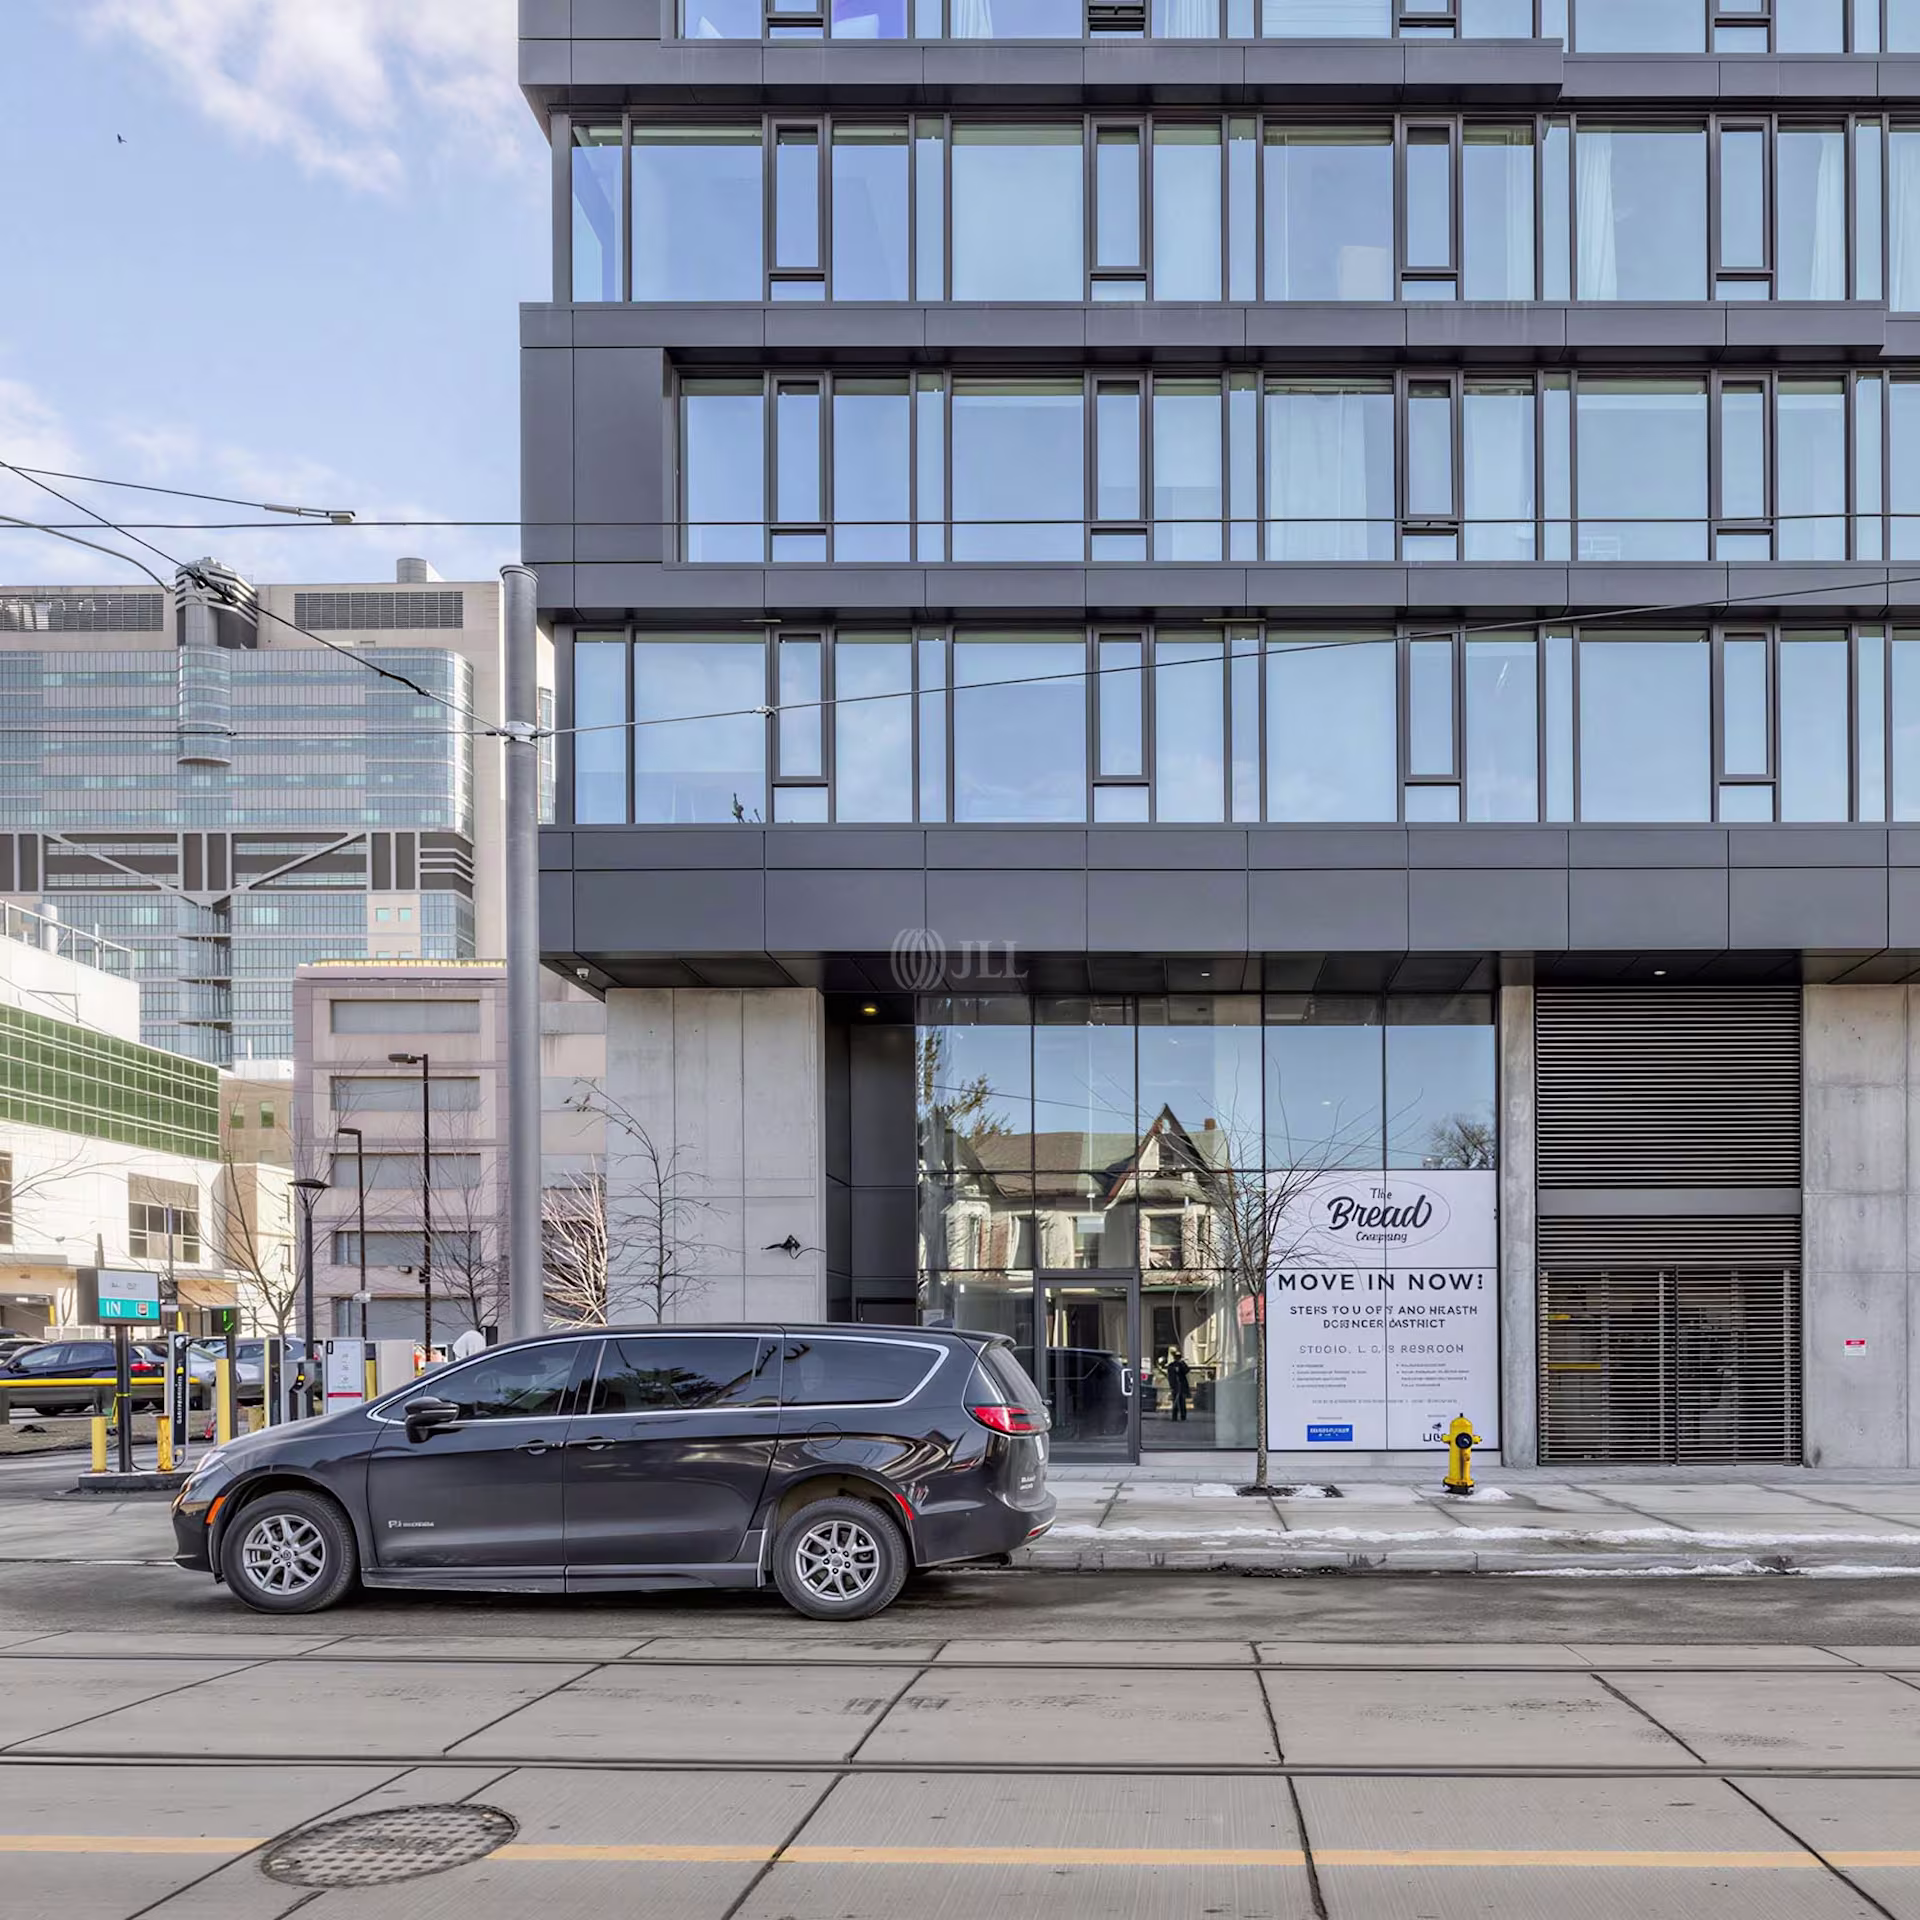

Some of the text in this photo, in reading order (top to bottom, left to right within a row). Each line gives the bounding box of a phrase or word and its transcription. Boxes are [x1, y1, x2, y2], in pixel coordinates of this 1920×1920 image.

[1327, 1194, 1433, 1231] Bread
[1278, 1273, 1484, 1291] MOVE IN NOW!
[105, 1300, 122, 1317] IN
[1332, 1305, 1349, 1315] TO
[1353, 1305, 1361, 1315] U
